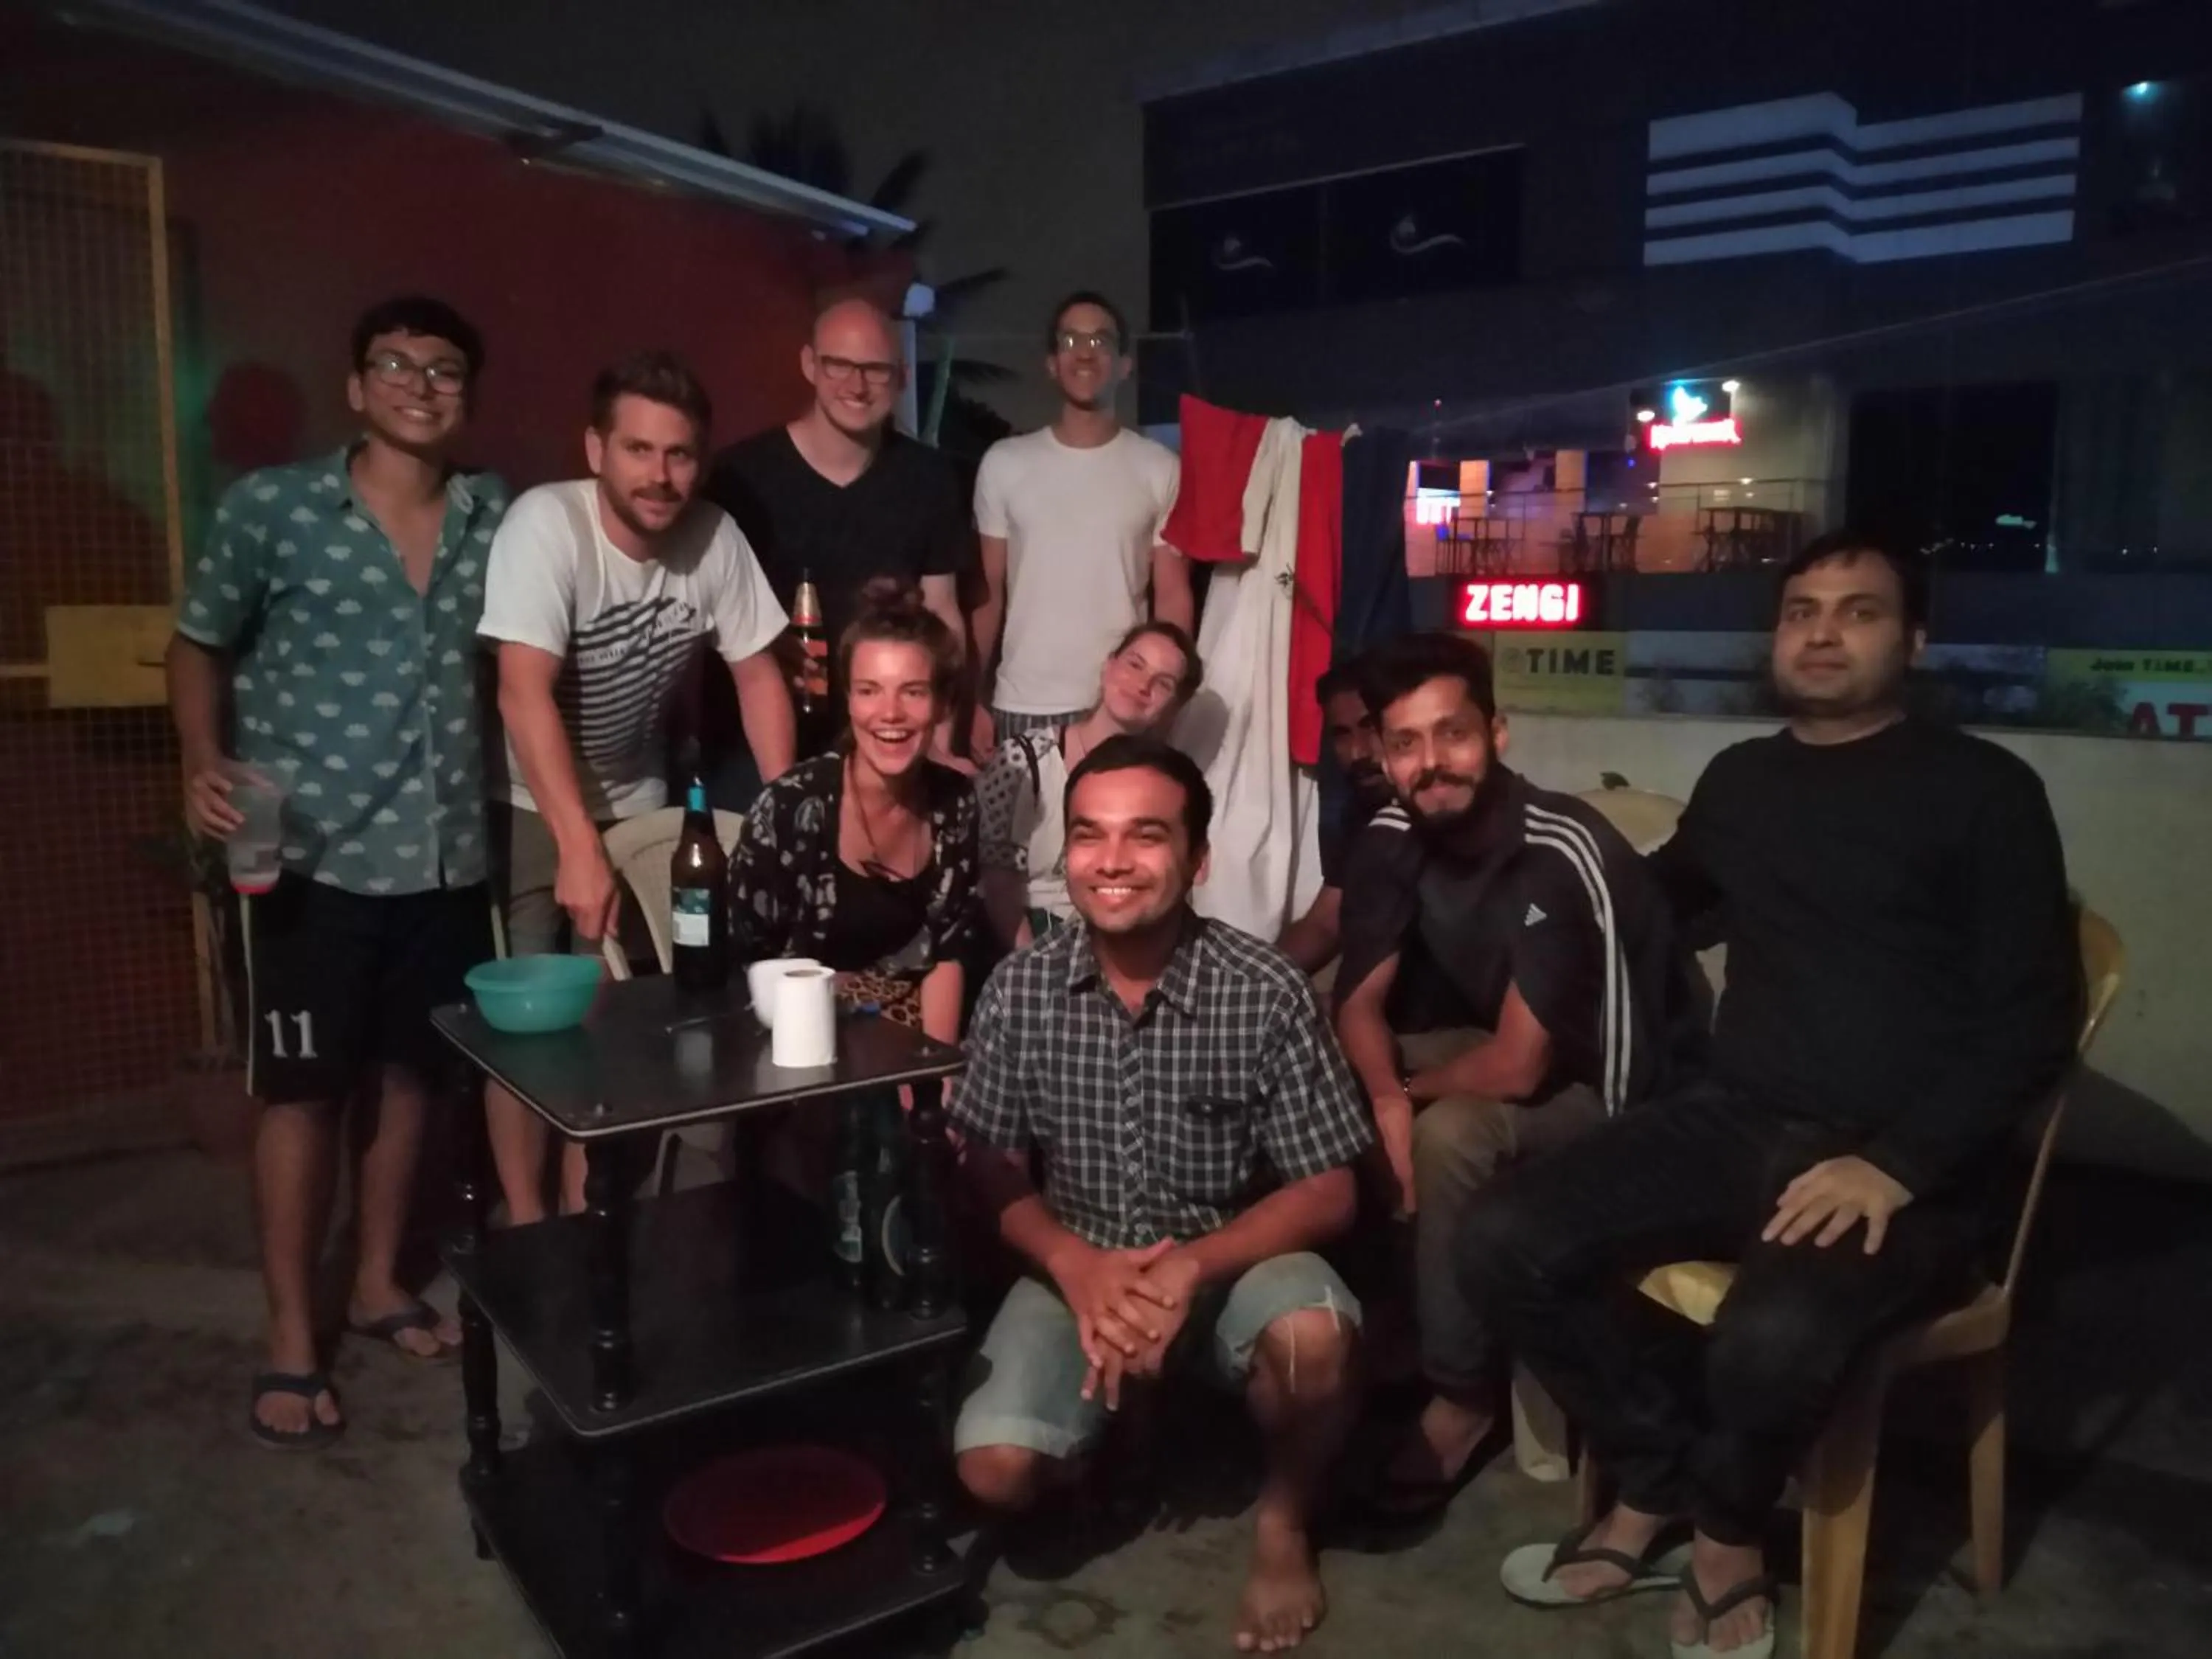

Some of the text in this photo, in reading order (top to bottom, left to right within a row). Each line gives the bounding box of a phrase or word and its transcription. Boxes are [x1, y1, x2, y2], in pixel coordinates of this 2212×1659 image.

[1464, 583, 1579, 622] ZENGI
[1526, 648, 1616, 675] TIME
[263, 1009, 319, 1059] 11
